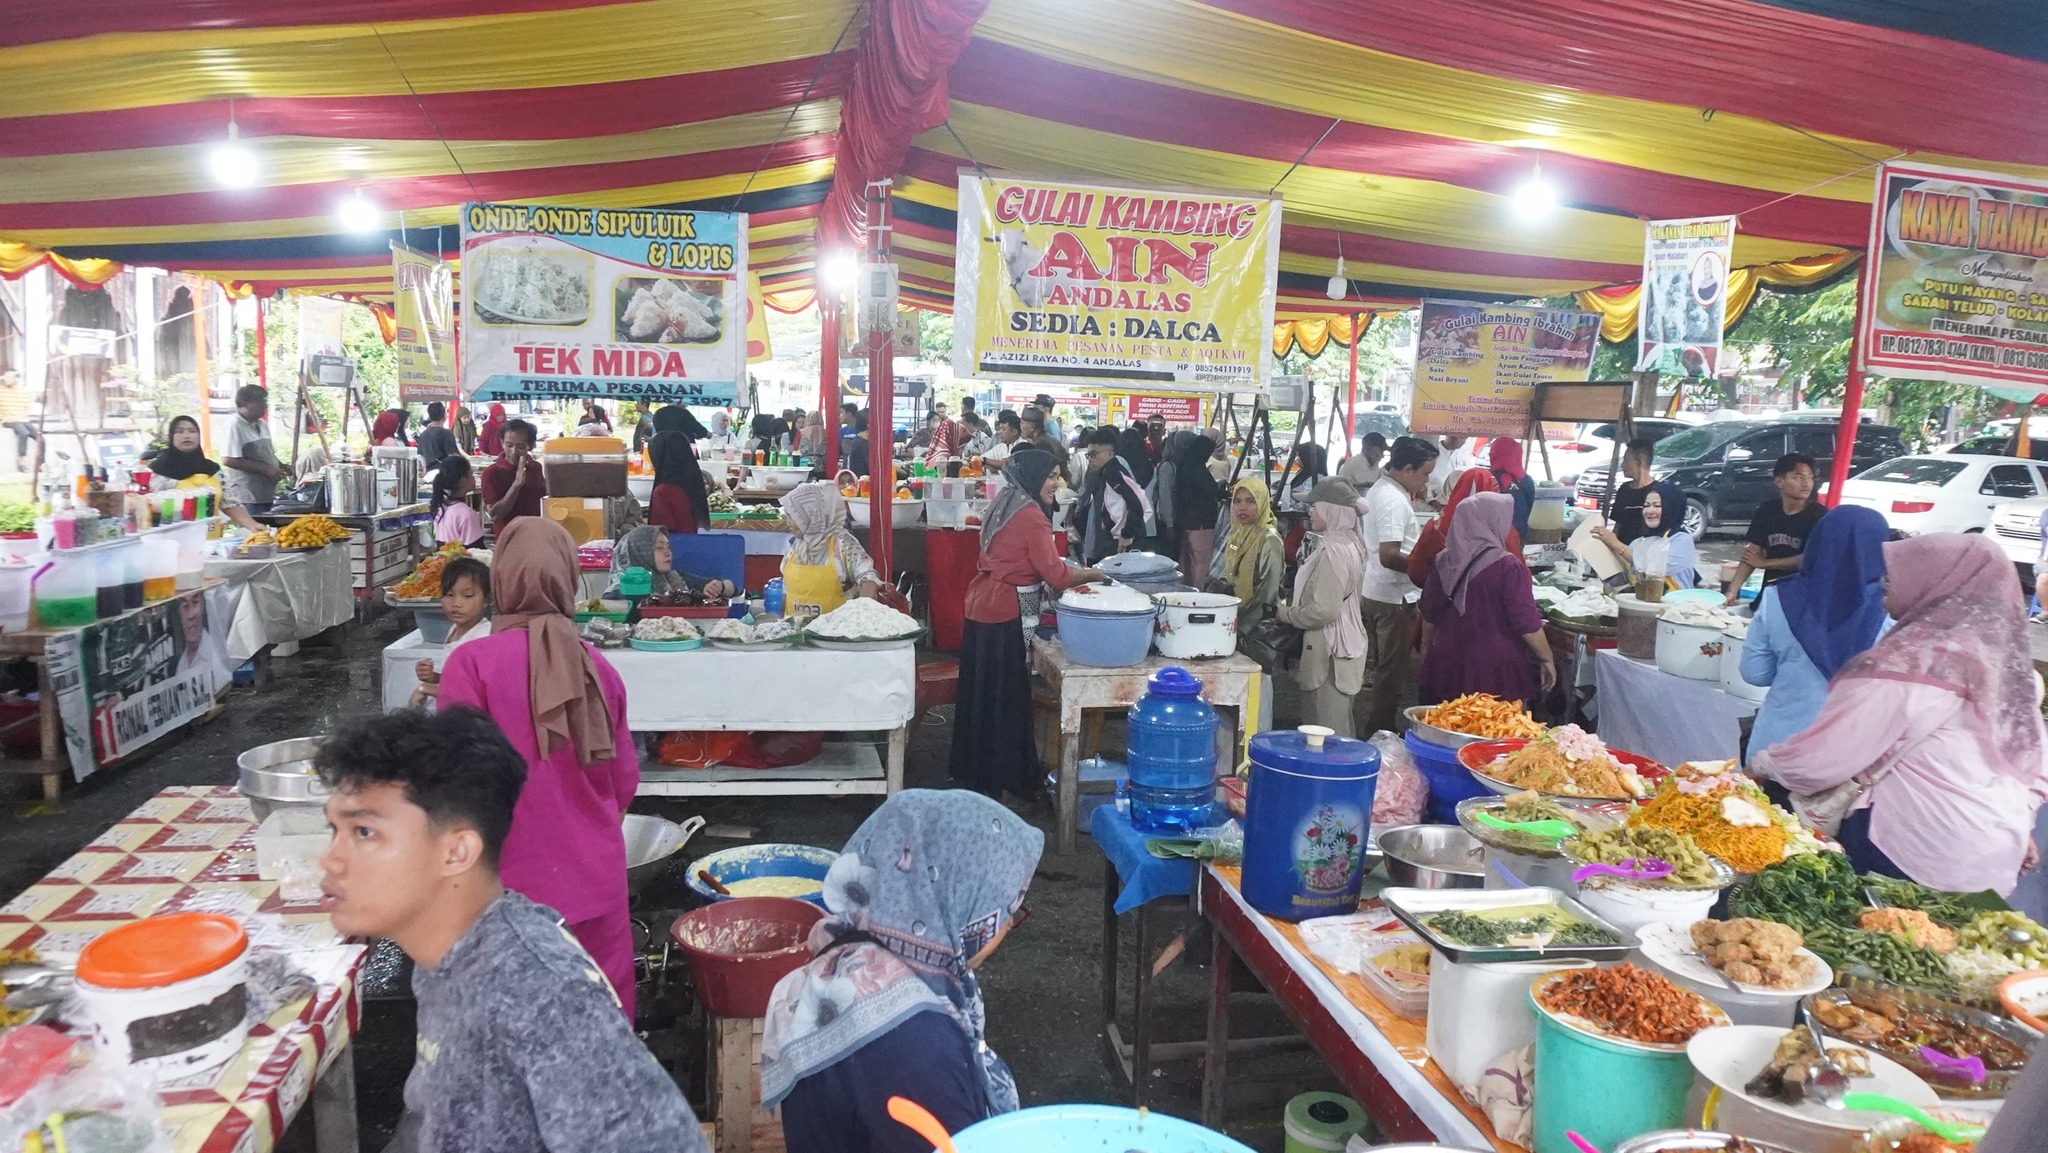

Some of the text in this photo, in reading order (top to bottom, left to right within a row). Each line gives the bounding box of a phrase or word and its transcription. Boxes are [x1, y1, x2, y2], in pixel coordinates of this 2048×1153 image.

[469, 208, 697, 239] ONDE-ONDE SIPULUIK
[995, 186, 1257, 240] GULAI KAMBING
[1900, 188, 1970, 248] KAYA
[648, 242, 733, 270] & LOPIS
[1028, 231, 1219, 288] AIN
[1047, 285, 1191, 313] ANDALAS
[1953, 300, 1997, 316] TELUR
[1962, 284, 2016, 303] MAYANG
[2029, 292, 2048, 307] SA
[1010, 311, 1102, 336] SEDIA
[1123, 318, 1222, 342] DALCA
[1444, 312, 1576, 341] Gulai Kambing Ibrahim
[1492, 325, 1528, 342] AIN
[1933, 319, 1999, 338] MENERIMA
[513, 345, 687, 378] TEK MIDA
[991, 336, 1058, 351] MENERIMA
[1067, 340, 1124, 354] PESANAN
[1133, 344, 1173, 359] PESTA
[1180, 348, 1188, 358] &
[1000, 353, 1029, 362] AZIZI
[1032, 354, 1059, 364] RAYA
[1062, 356, 1080, 364] NO.
[1083, 357, 1090, 365] 4
[1092, 358, 1142, 368] ANDALAS
[1882, 336, 1895, 352] HP.
[1897, 337, 1920, 355] 0812
[2003, 349, 2025, 367] 0813
[1177, 363, 1188, 371] HP
[1498, 362, 1517, 370] Ayam
[520, 379, 704, 395] TERIMA PESANAN
